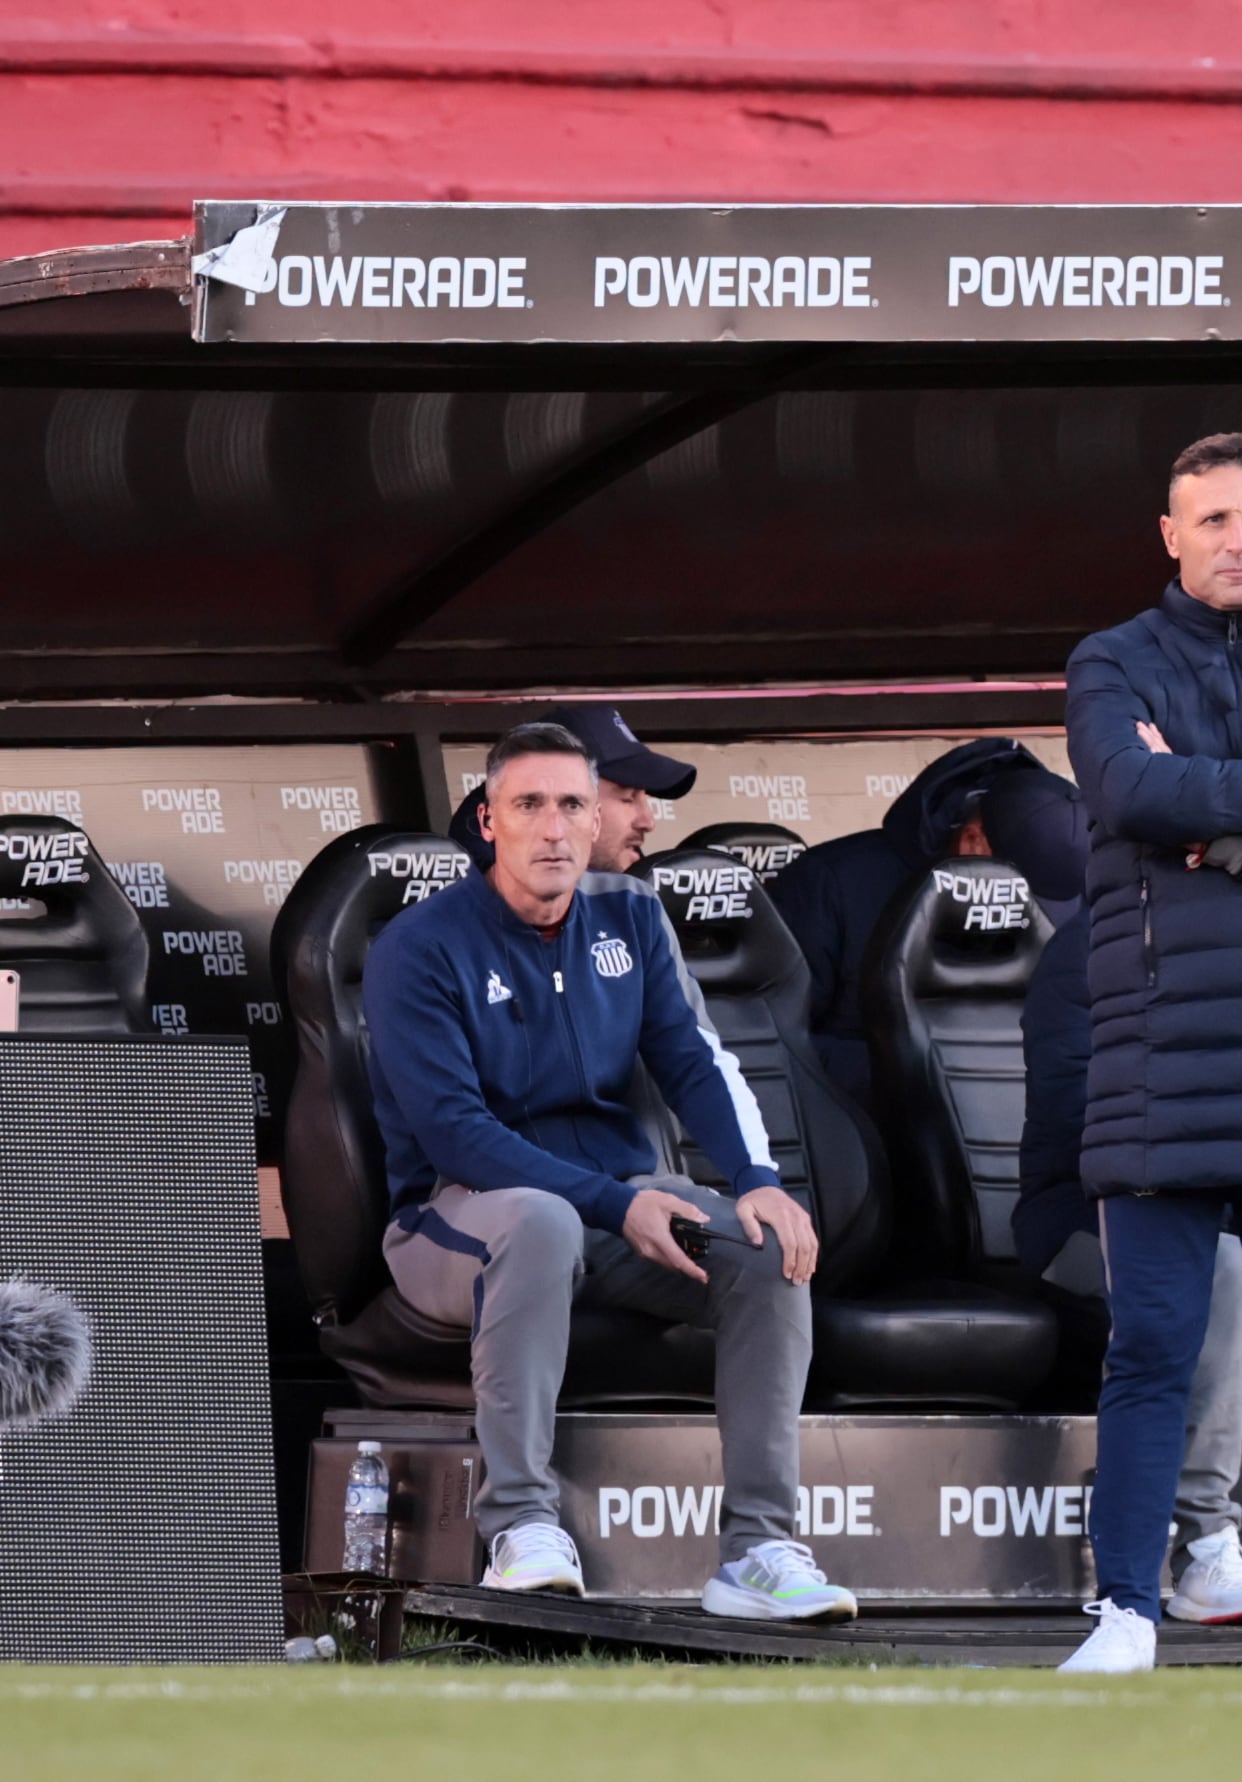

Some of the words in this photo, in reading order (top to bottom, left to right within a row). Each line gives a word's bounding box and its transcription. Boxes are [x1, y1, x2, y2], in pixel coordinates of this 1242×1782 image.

[594, 256, 871, 307] POWERADE
[948, 256, 1223, 306] POWERADE
[281, 787, 360, 809] POWER
[730, 776, 807, 797] POWER
[0, 791, 81, 813] POWER
[142, 789, 223, 811] POWER
[767, 800, 811, 820] ADE
[181, 812, 225, 833] ADE
[21, 858, 84, 887] ADE
[368, 853, 471, 879] POWER
[402, 879, 457, 904] AD
[653, 867, 753, 893] POWER
[933, 870, 1029, 902] POWER
[264, 884, 292, 905] AD
[686, 893, 748, 921] ADE
[964, 904, 1023, 931] ADE
[163, 931, 244, 954] POWER
[203, 954, 248, 976] ADE
